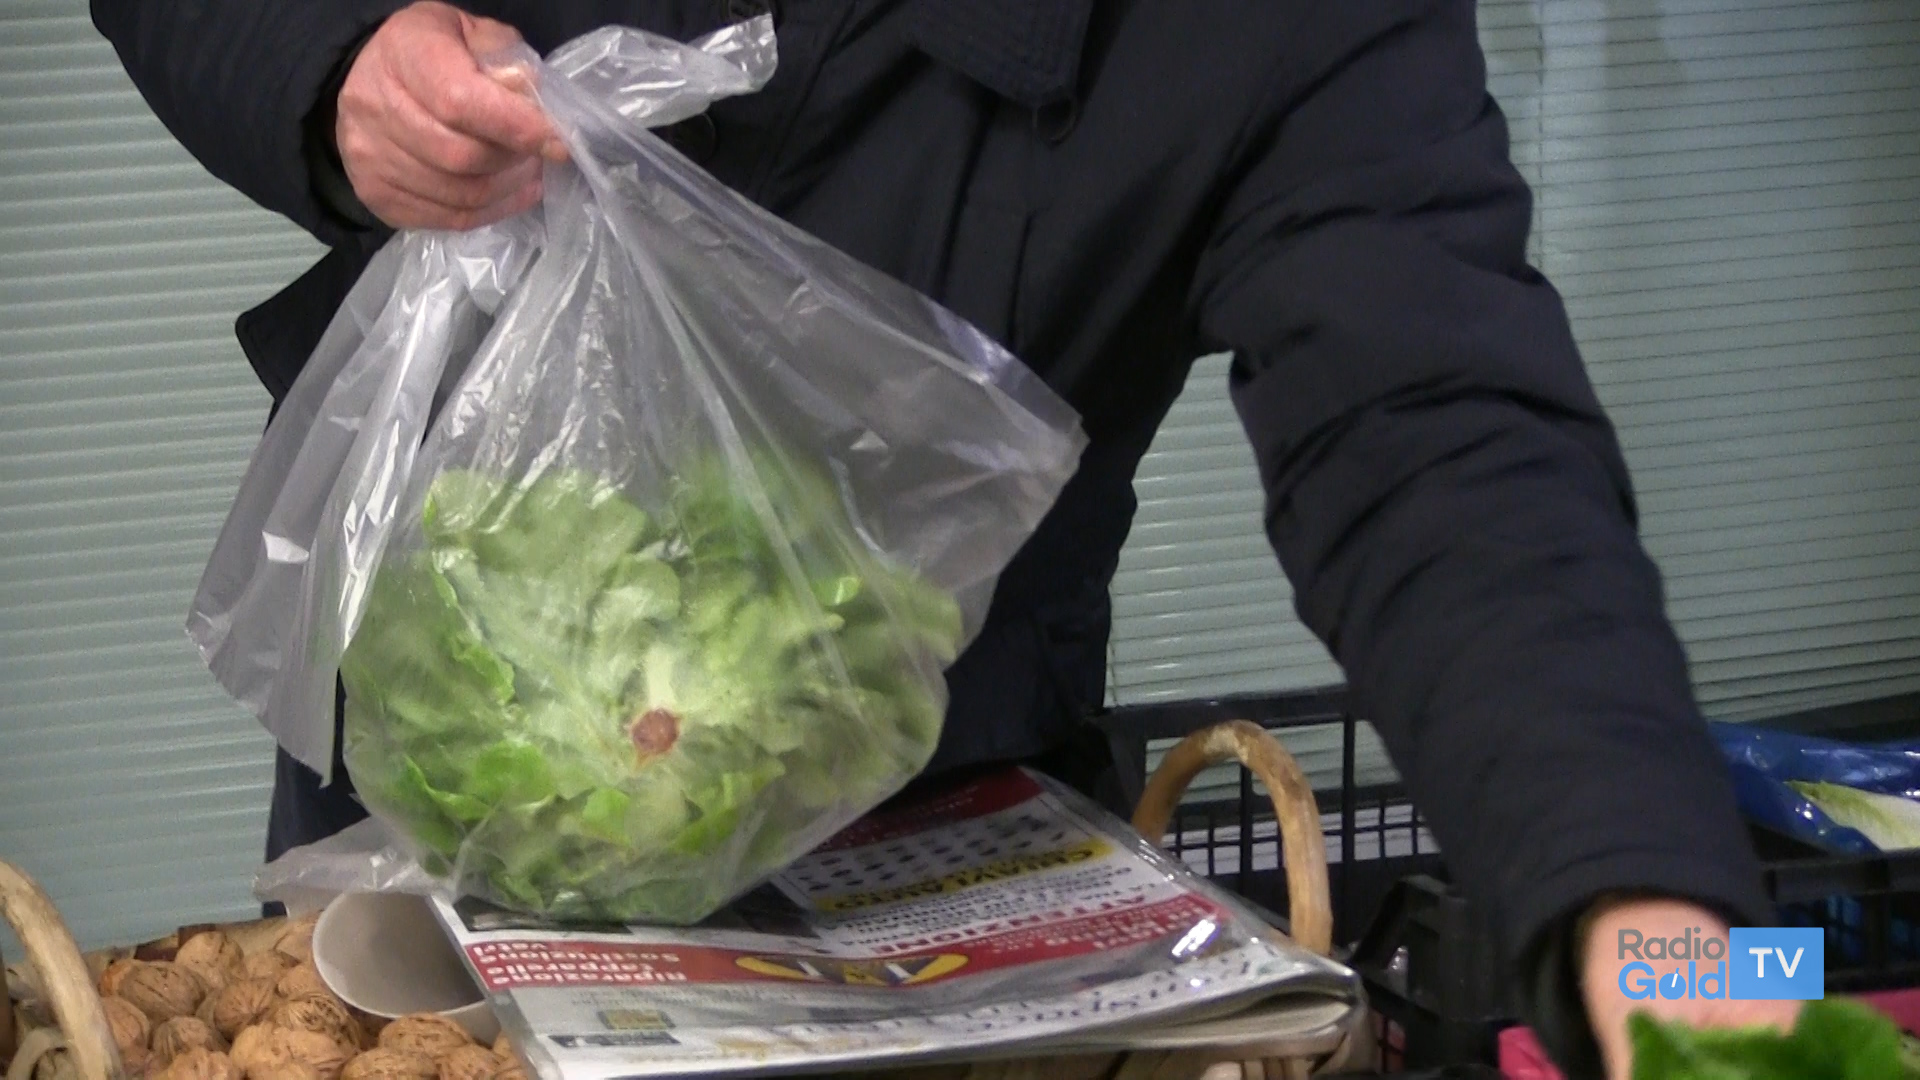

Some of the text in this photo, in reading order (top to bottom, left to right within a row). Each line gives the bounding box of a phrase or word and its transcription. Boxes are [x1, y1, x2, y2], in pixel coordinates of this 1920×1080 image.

[957, 847, 1094, 890] CHIAVI
[870, 895, 1146, 954] ATTENZIONE
[473, 942, 547, 956] vetri
